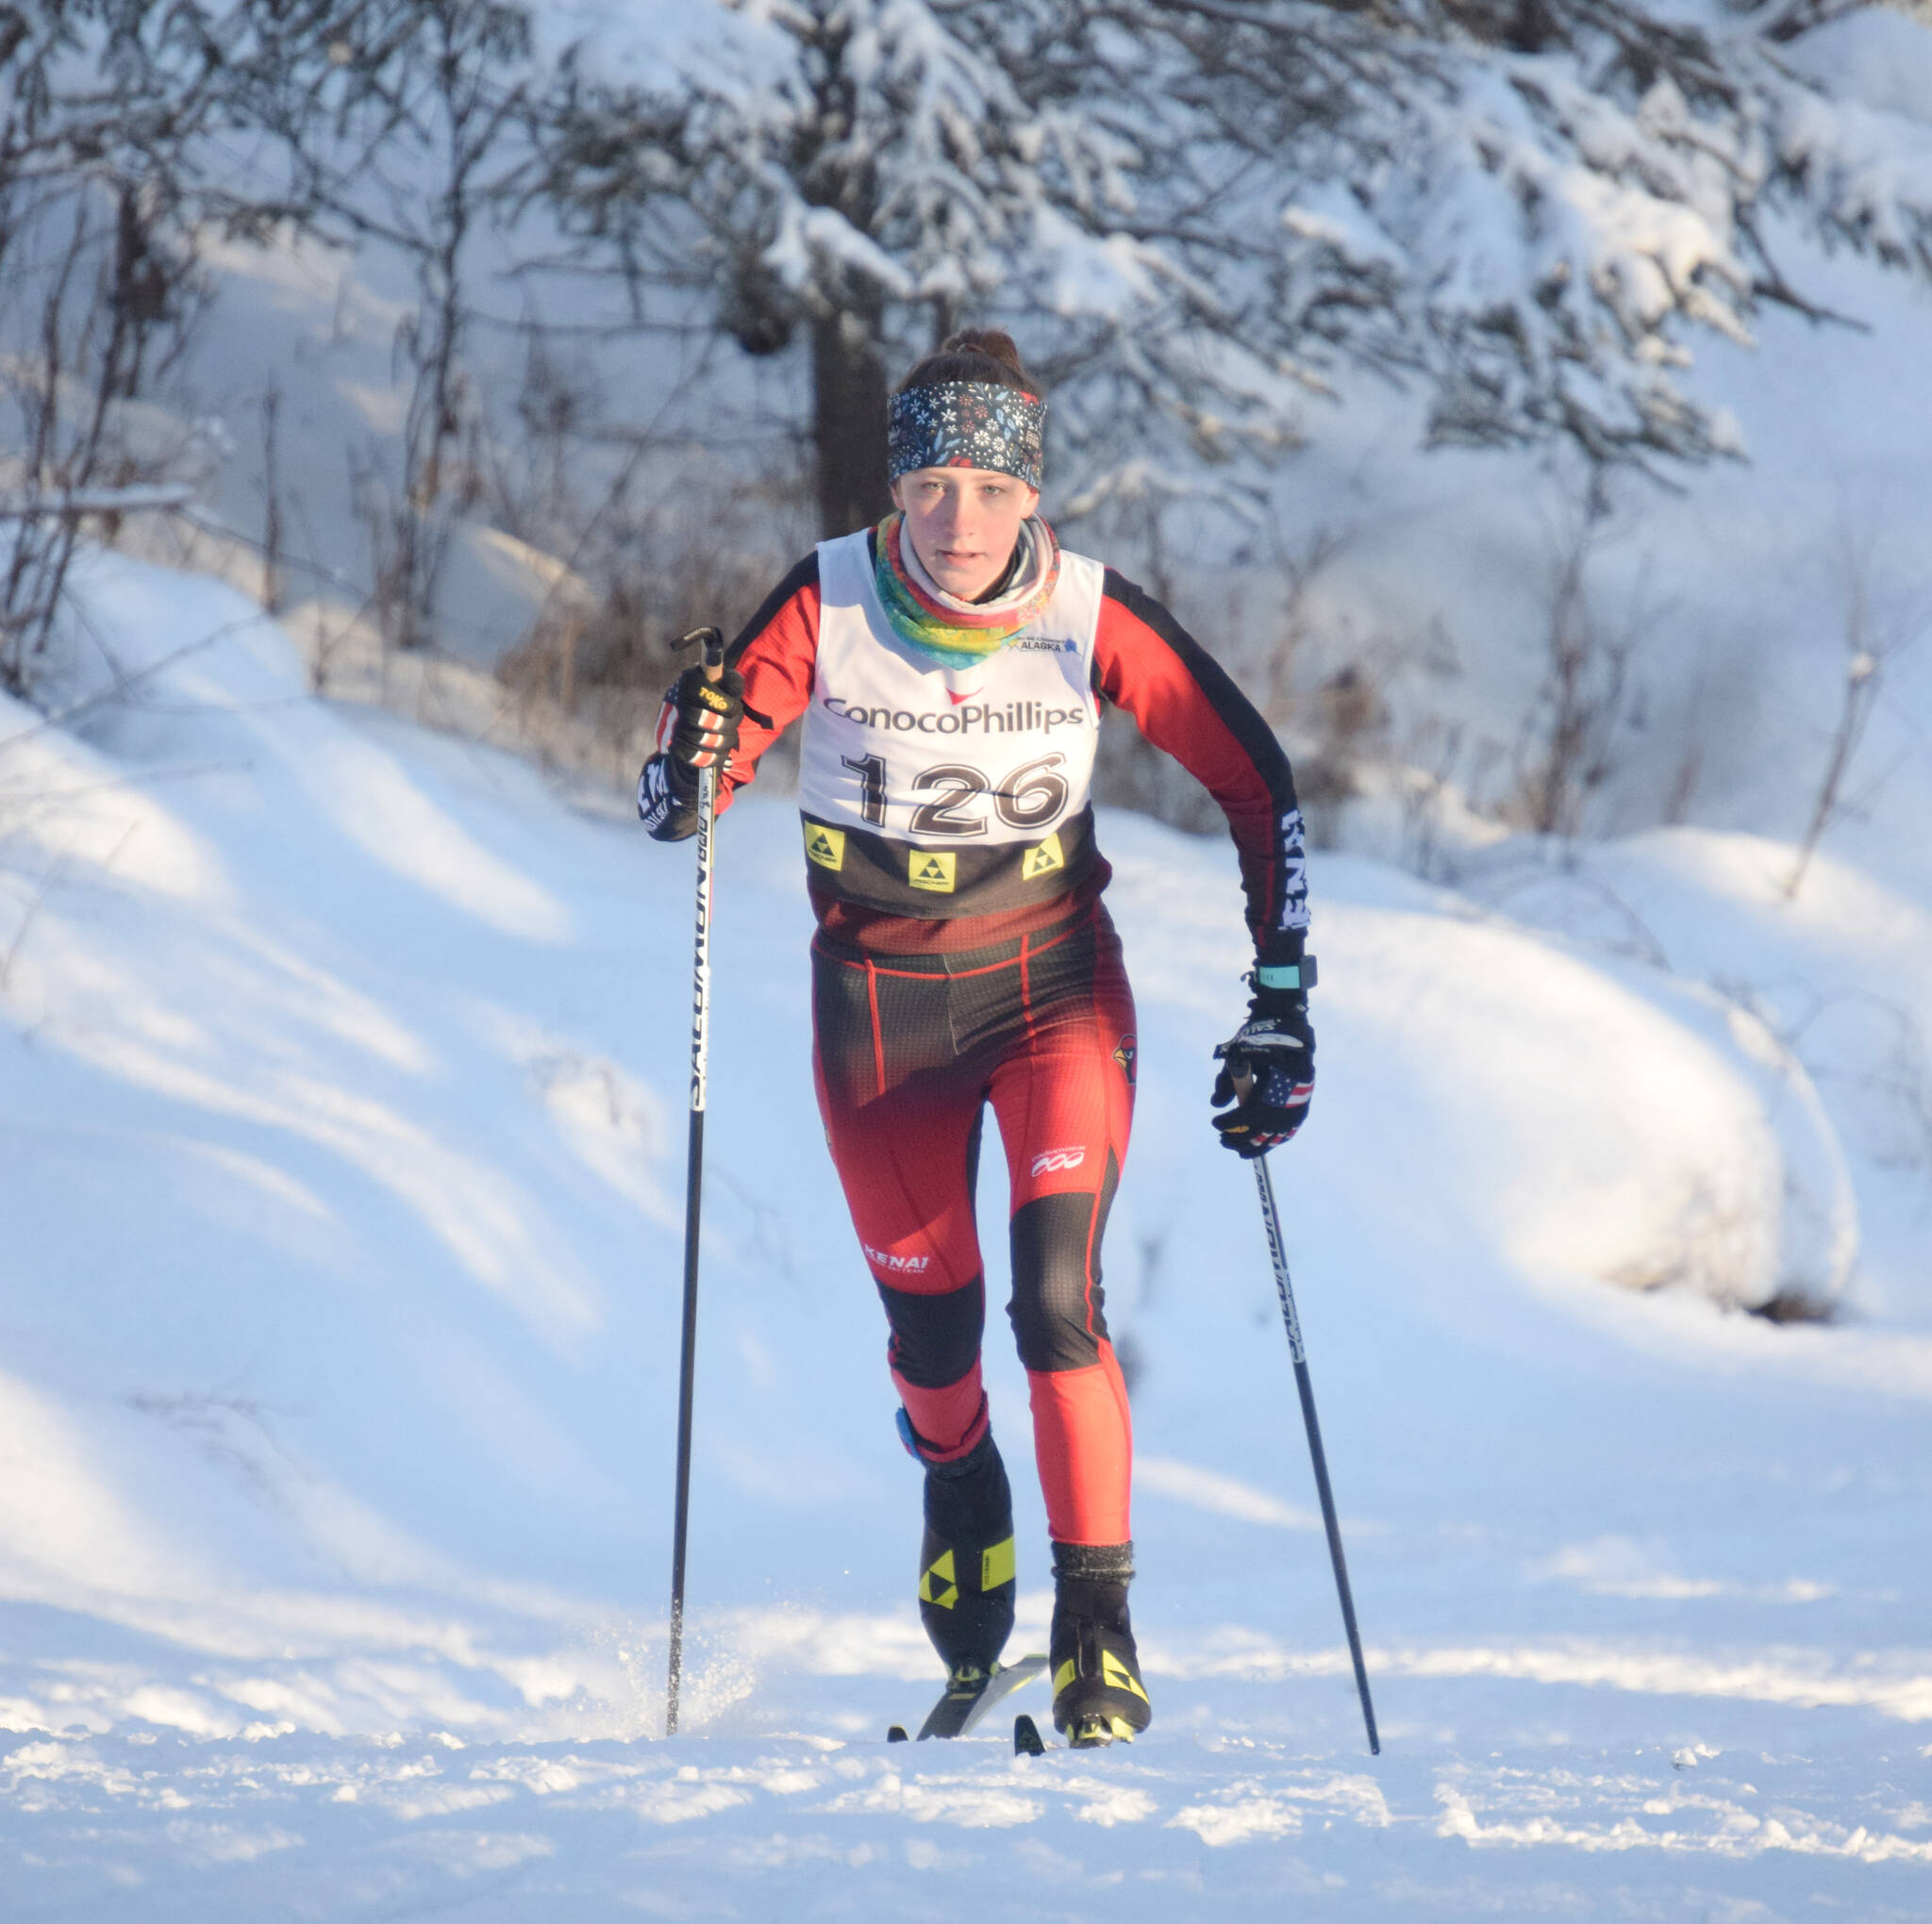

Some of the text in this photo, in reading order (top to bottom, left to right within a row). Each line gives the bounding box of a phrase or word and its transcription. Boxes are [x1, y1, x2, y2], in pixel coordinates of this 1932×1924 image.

[1021, 640, 1061, 653] ALASKA
[698, 686, 728, 710] TOKO
[823, 697, 1084, 735] ConocoPhillips
[841, 752, 1069, 838] 126
[864, 1243, 929, 1269] KENAI
